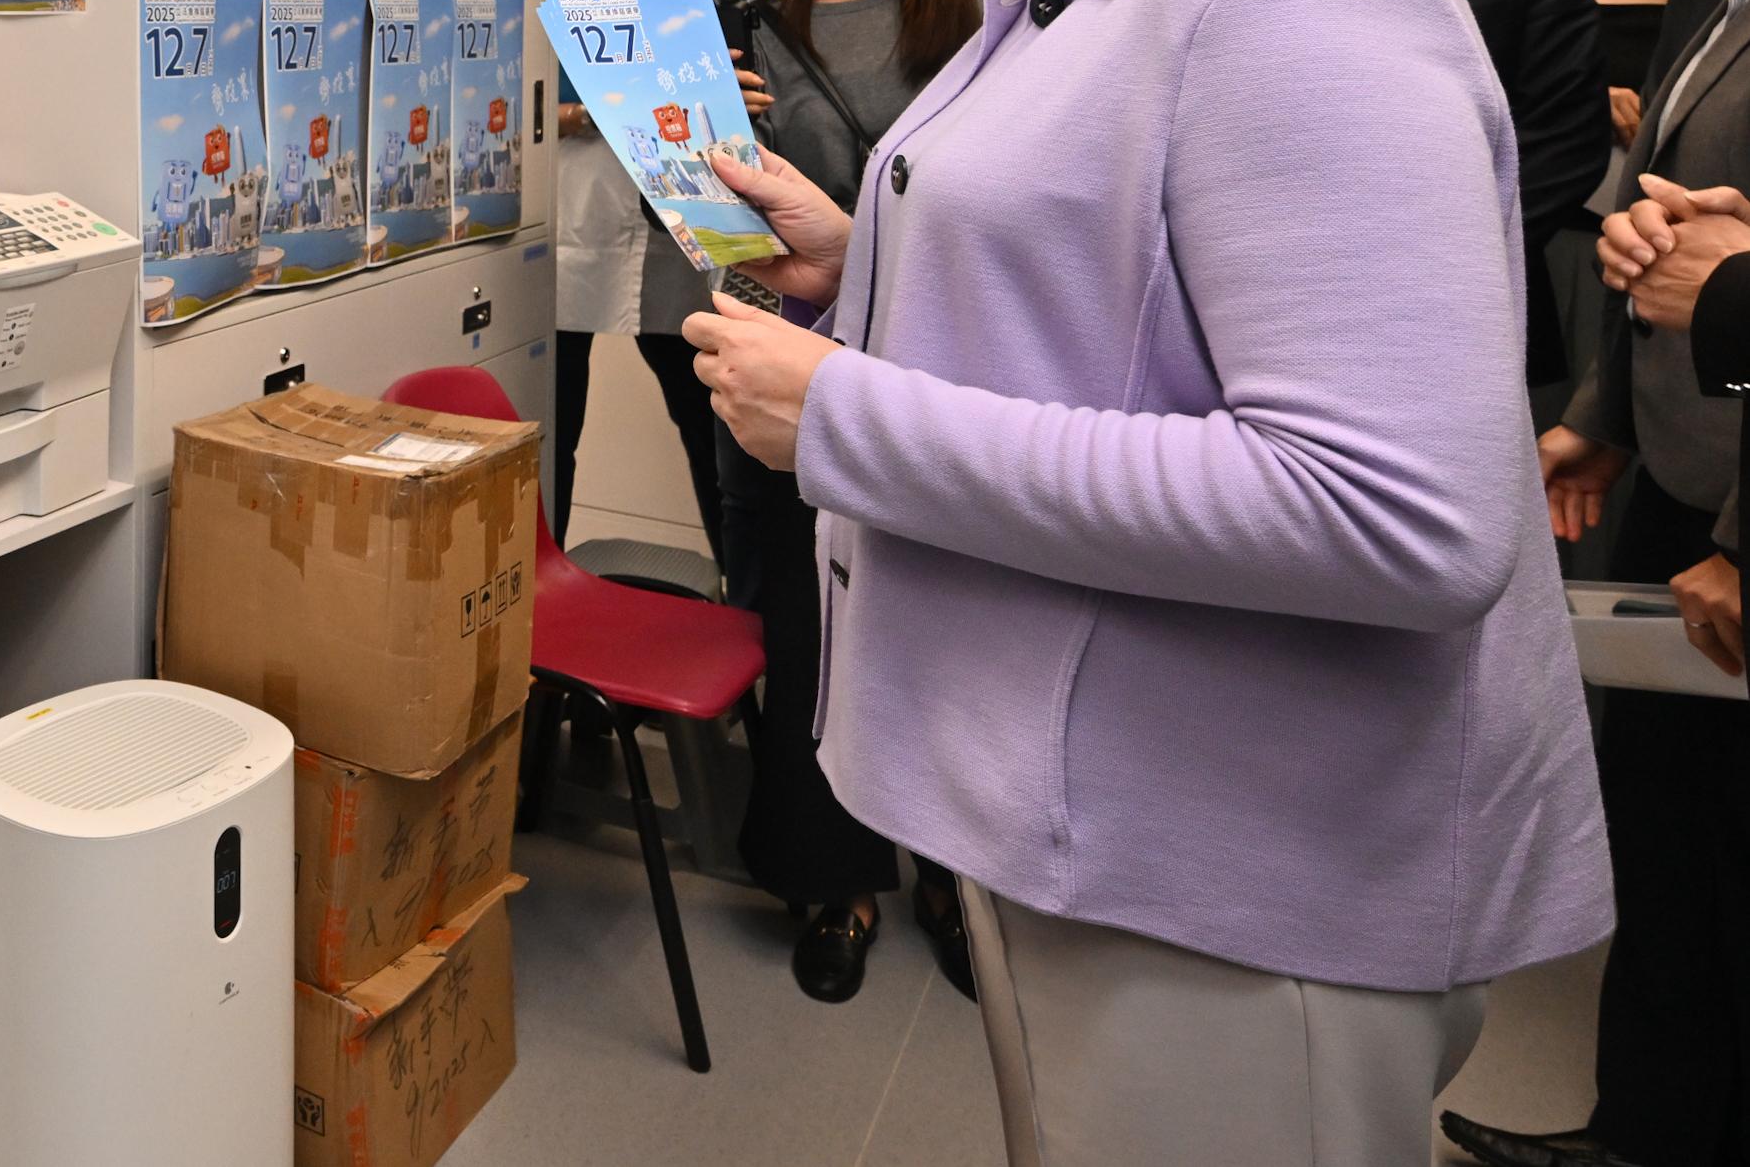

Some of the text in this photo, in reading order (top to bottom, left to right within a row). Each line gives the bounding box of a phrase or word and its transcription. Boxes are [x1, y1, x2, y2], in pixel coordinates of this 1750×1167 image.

[146, 7, 176, 23] 2025
[271, 7, 293, 22] 2025
[564, 9, 593, 21] 2025
